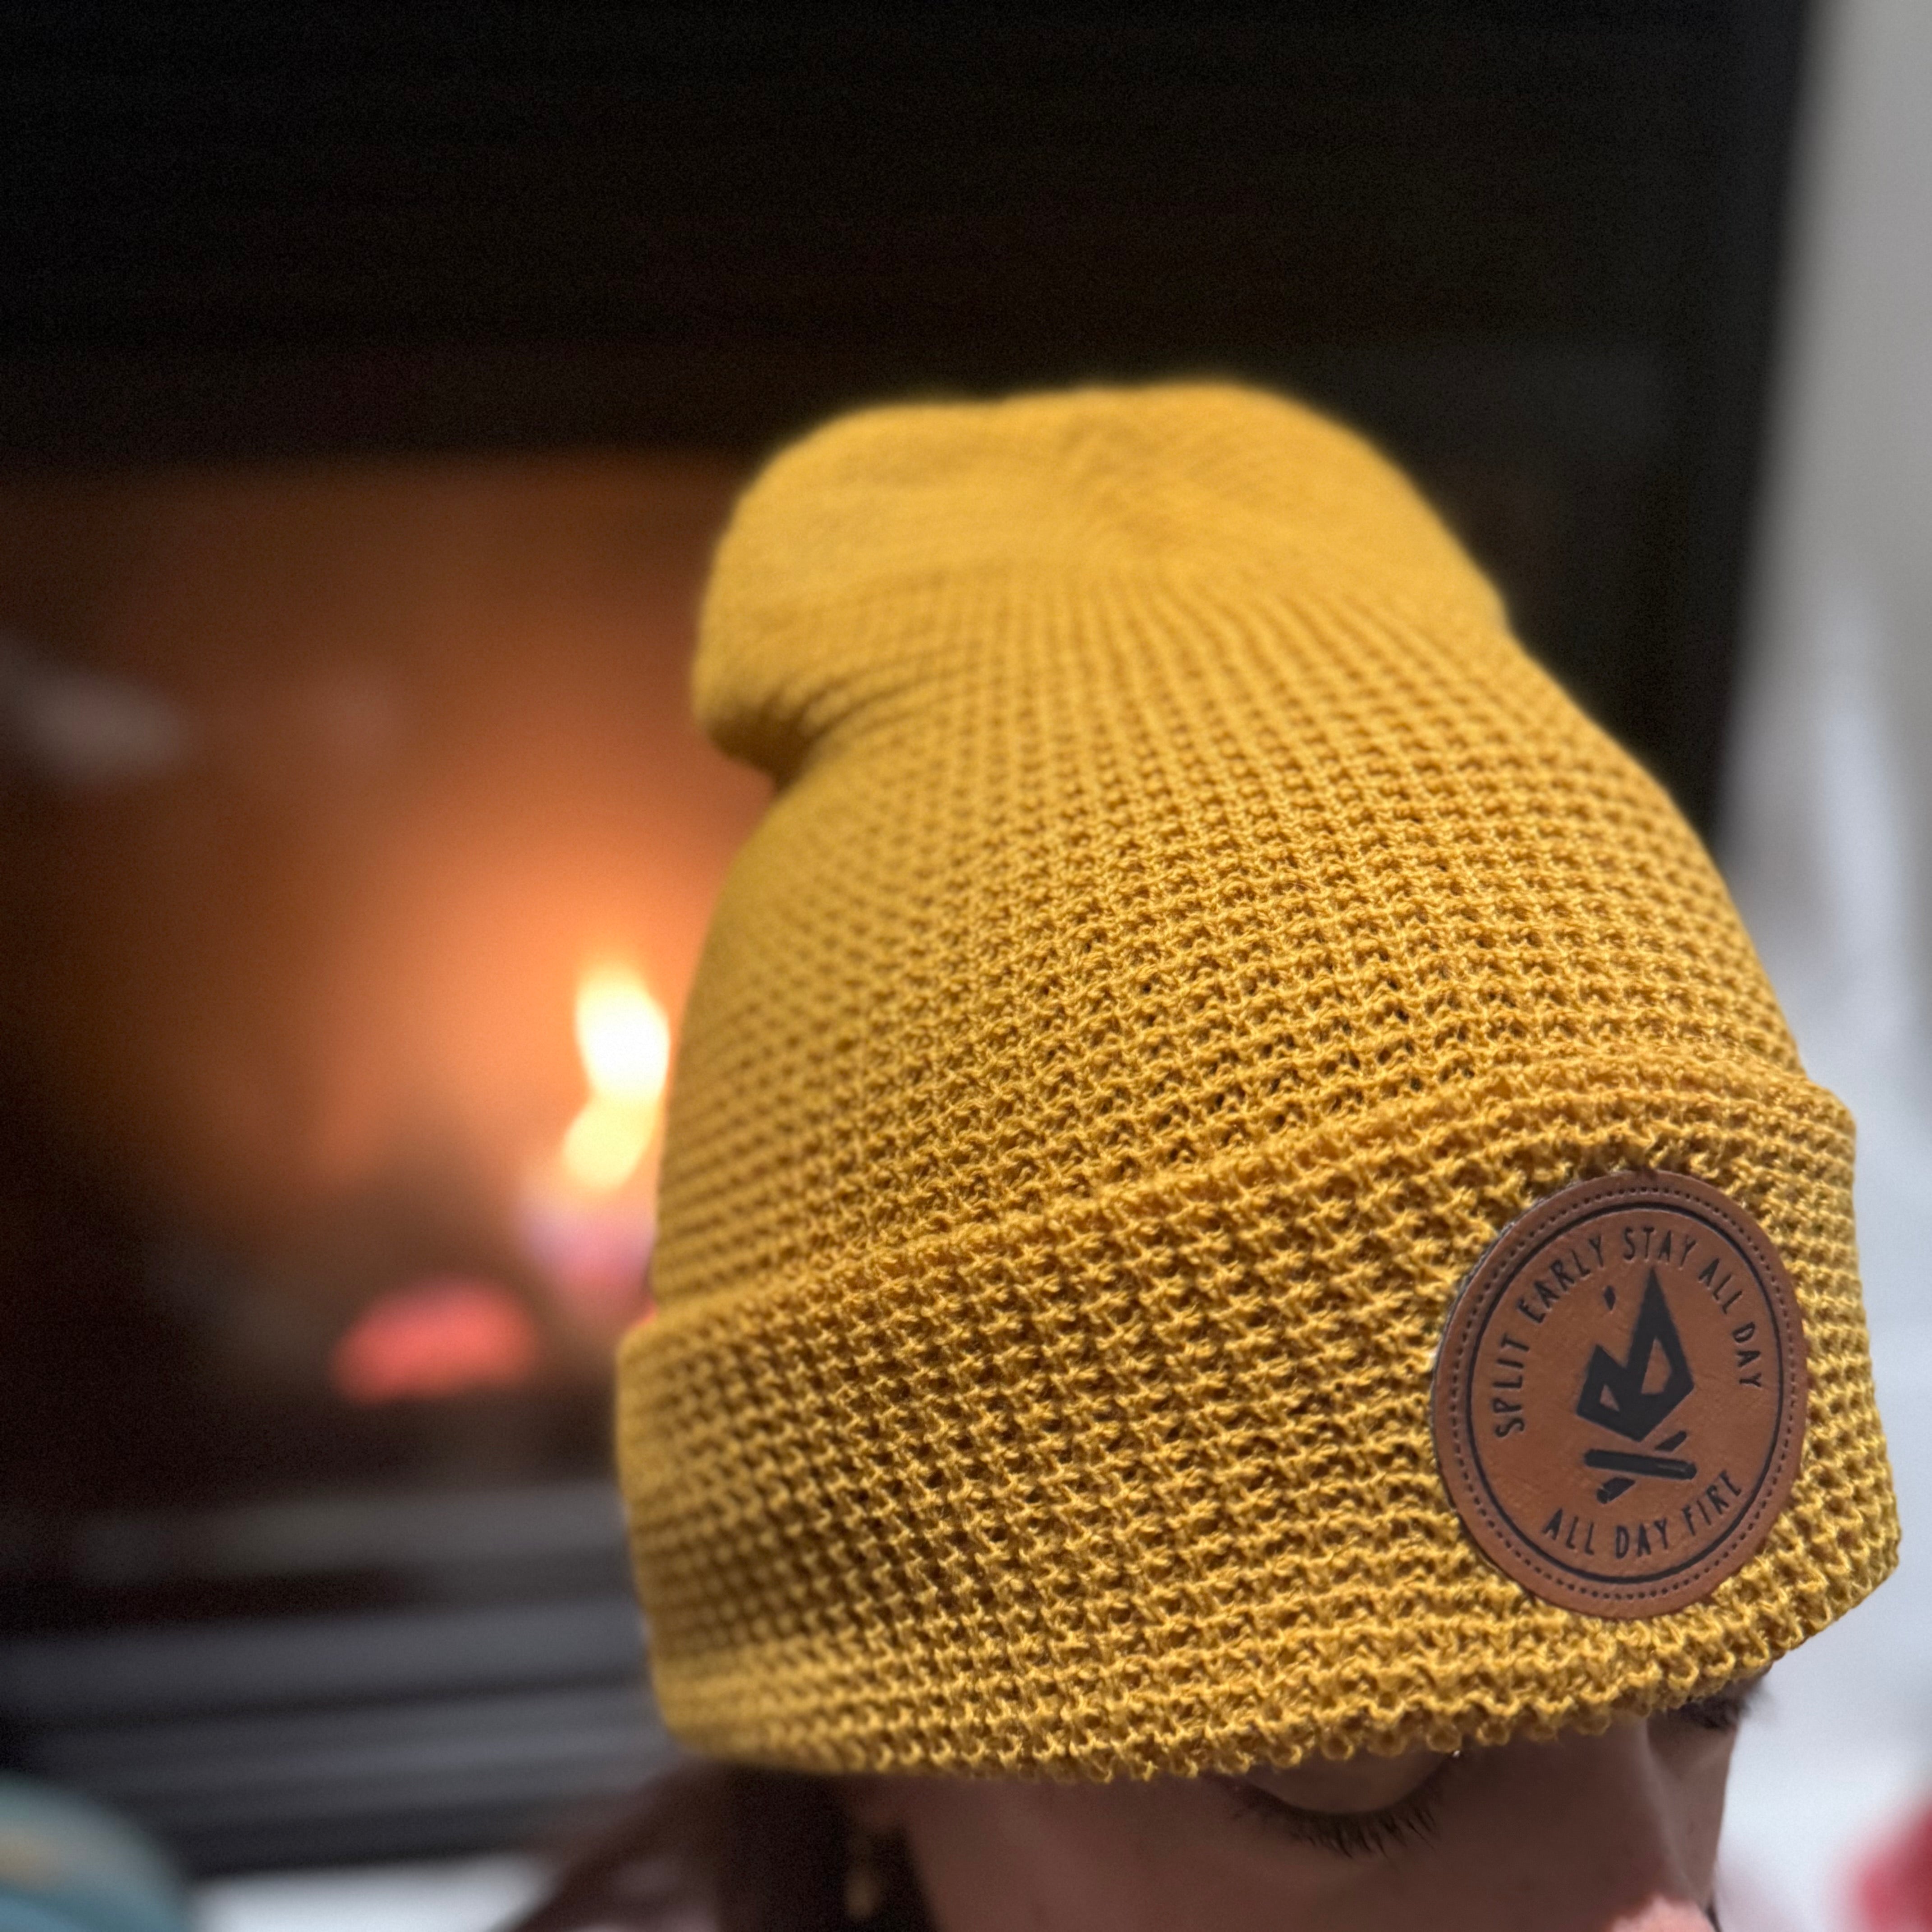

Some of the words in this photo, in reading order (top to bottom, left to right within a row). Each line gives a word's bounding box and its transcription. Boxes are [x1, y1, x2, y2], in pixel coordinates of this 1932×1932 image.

[1492, 1333, 1530, 1437] SPLIT
[1518, 1235, 1604, 1323] EARLY
[1623, 1225, 1697, 1267] STAY
[1698, 1257, 1743, 1314] ALL
[1732, 1321, 1762, 1388] DAY
[1542, 1508, 1594, 1555] ALL
[1615, 1521, 1668, 1559] DAY
